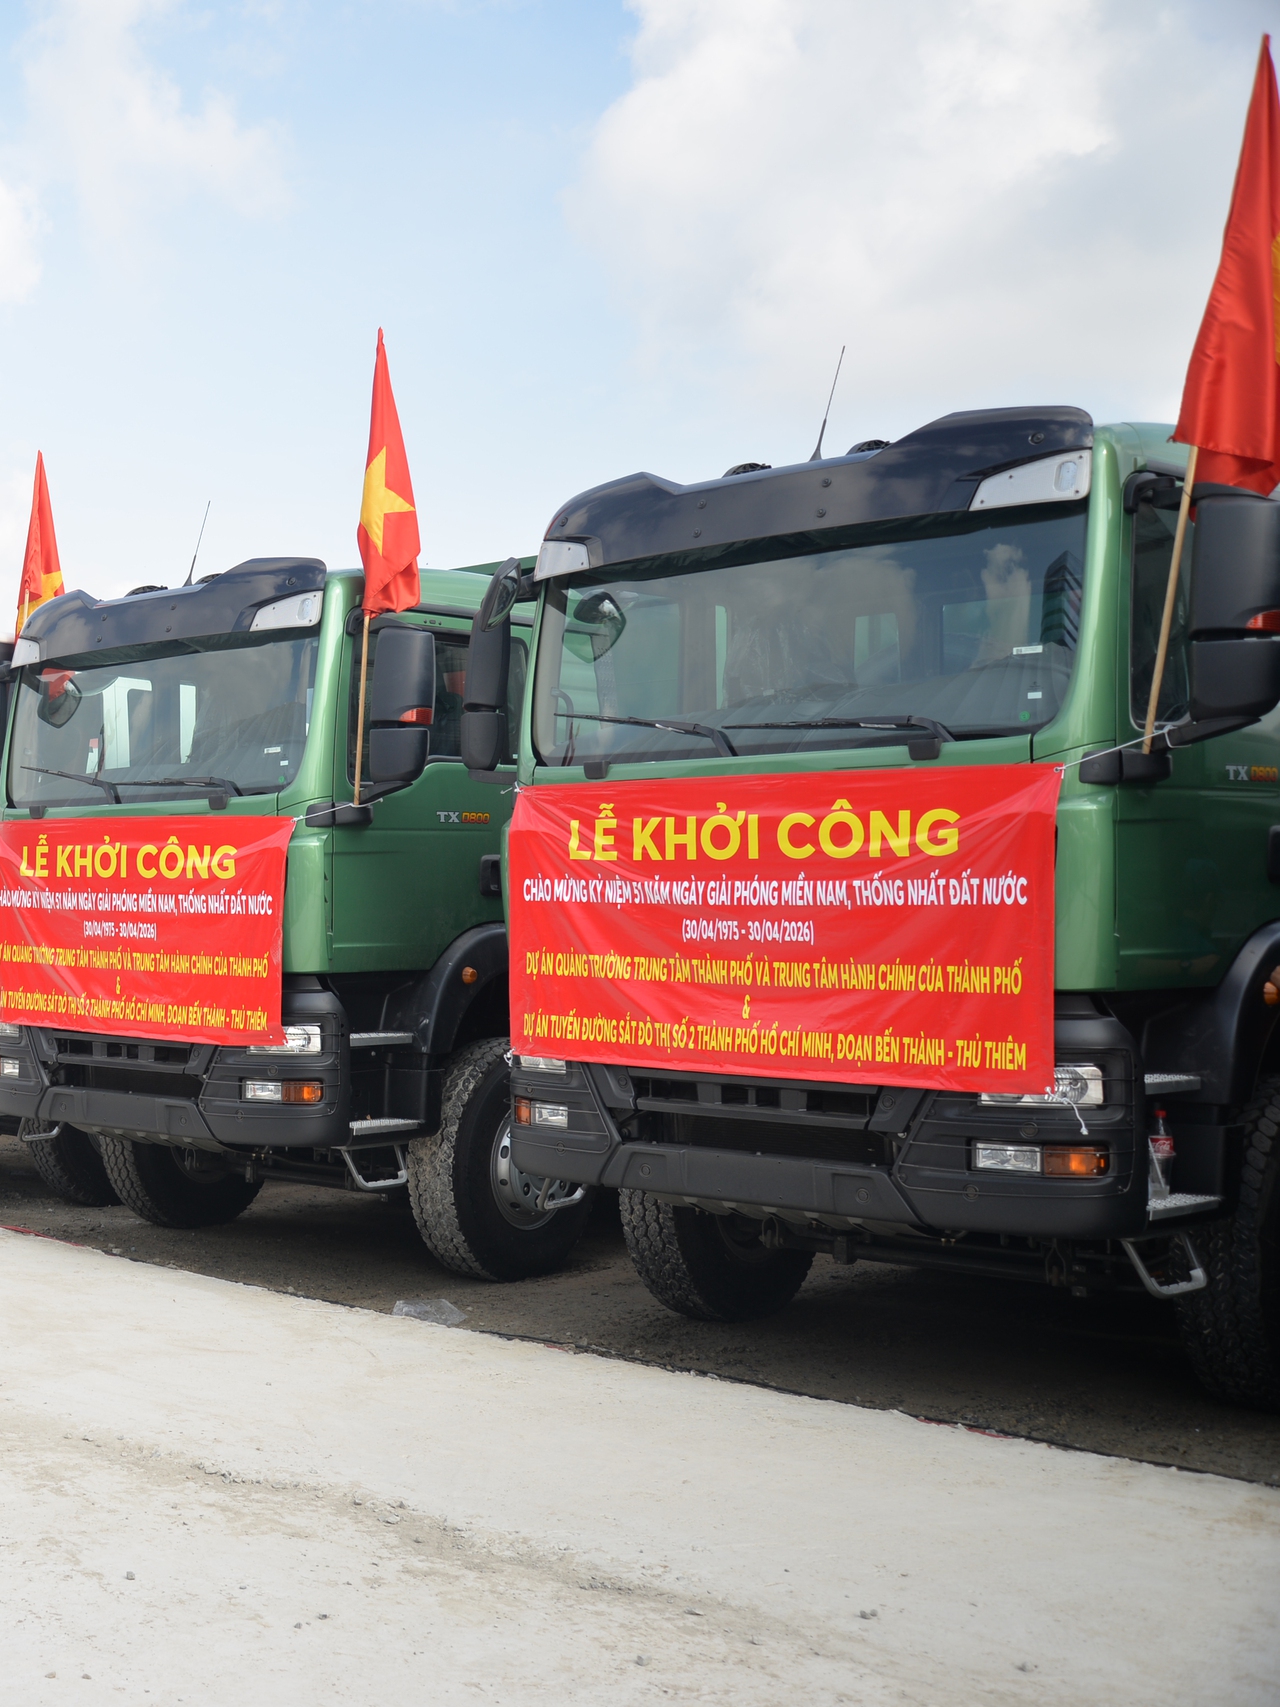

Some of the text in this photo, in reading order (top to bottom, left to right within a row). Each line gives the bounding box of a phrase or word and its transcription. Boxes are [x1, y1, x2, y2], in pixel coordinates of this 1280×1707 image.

[1225, 765, 1249, 781] TX
[436, 811, 490, 824] TX D800
[568, 799, 961, 861] LỄ KHỞI CÔNG
[21, 834, 238, 880] LỄ KHỞI CÔNG
[78, 888, 97, 910] NGÀY
[112, 889, 137, 912] PHÓNG
[139, 887, 157, 912] MIỀN
[158, 893, 178, 916] NAM,
[178, 888, 206, 914] THỐNG
[208, 888, 229, 914] NHẤT
[230, 888, 246, 914] ĐẤT
[248, 890, 273, 915] NƯỚC
[523, 869, 1028, 910] CHÀO MỪNG KỶ NIỆM 51 NĂM NGÀY GIẢI PHÓNG MIỀN NAM, THỐNG NHẤT ĐẤT NƯỚC
[119, 920, 157, 941] 30/04/2026)
[682, 918, 739, 943] (30/04/1975
[748, 918, 814, 945] 30/04/2026)
[526, 947, 1023, 995] DỰ ÁN QUẢNG TRƯỜNG TRUNG TÂM THÀNH PHỐ VÀ TRUNG TÂM HÀNH CHÍNH CỦA THÀNH PHỐ
[742, 994, 751, 1019] &
[523, 1012, 535, 1042] DỰ
[535, 1008, 549, 1038] ÁN
[550, 1009, 580, 1040] TUYẾN
[581, 1012, 618, 1043] ĐƯỜNG
[619, 1012, 637, 1044] SẮT
[638, 1016, 653, 1046] ĐÔ
[654, 1023, 671, 1052] THỊ
[672, 1016, 688, 1048] SỐ
[688, 1026, 695, 1049] 2
[697, 1020, 733, 1052] THÀNH
[735, 1020, 760, 1054] PHỐ
[760, 1021, 779, 1054] HỒ
[780, 1025, 801, 1056] CHÍ
[801, 1031, 834, 1063] MINH,
[837, 1034, 872, 1067] ĐOẠN
[875, 1027, 899, 1063] BẾN
[903, 1031, 945, 1066] THÀNH
[956, 1033, 982, 1068] THỦ
[985, 1035, 1026, 1071] THIÊM
